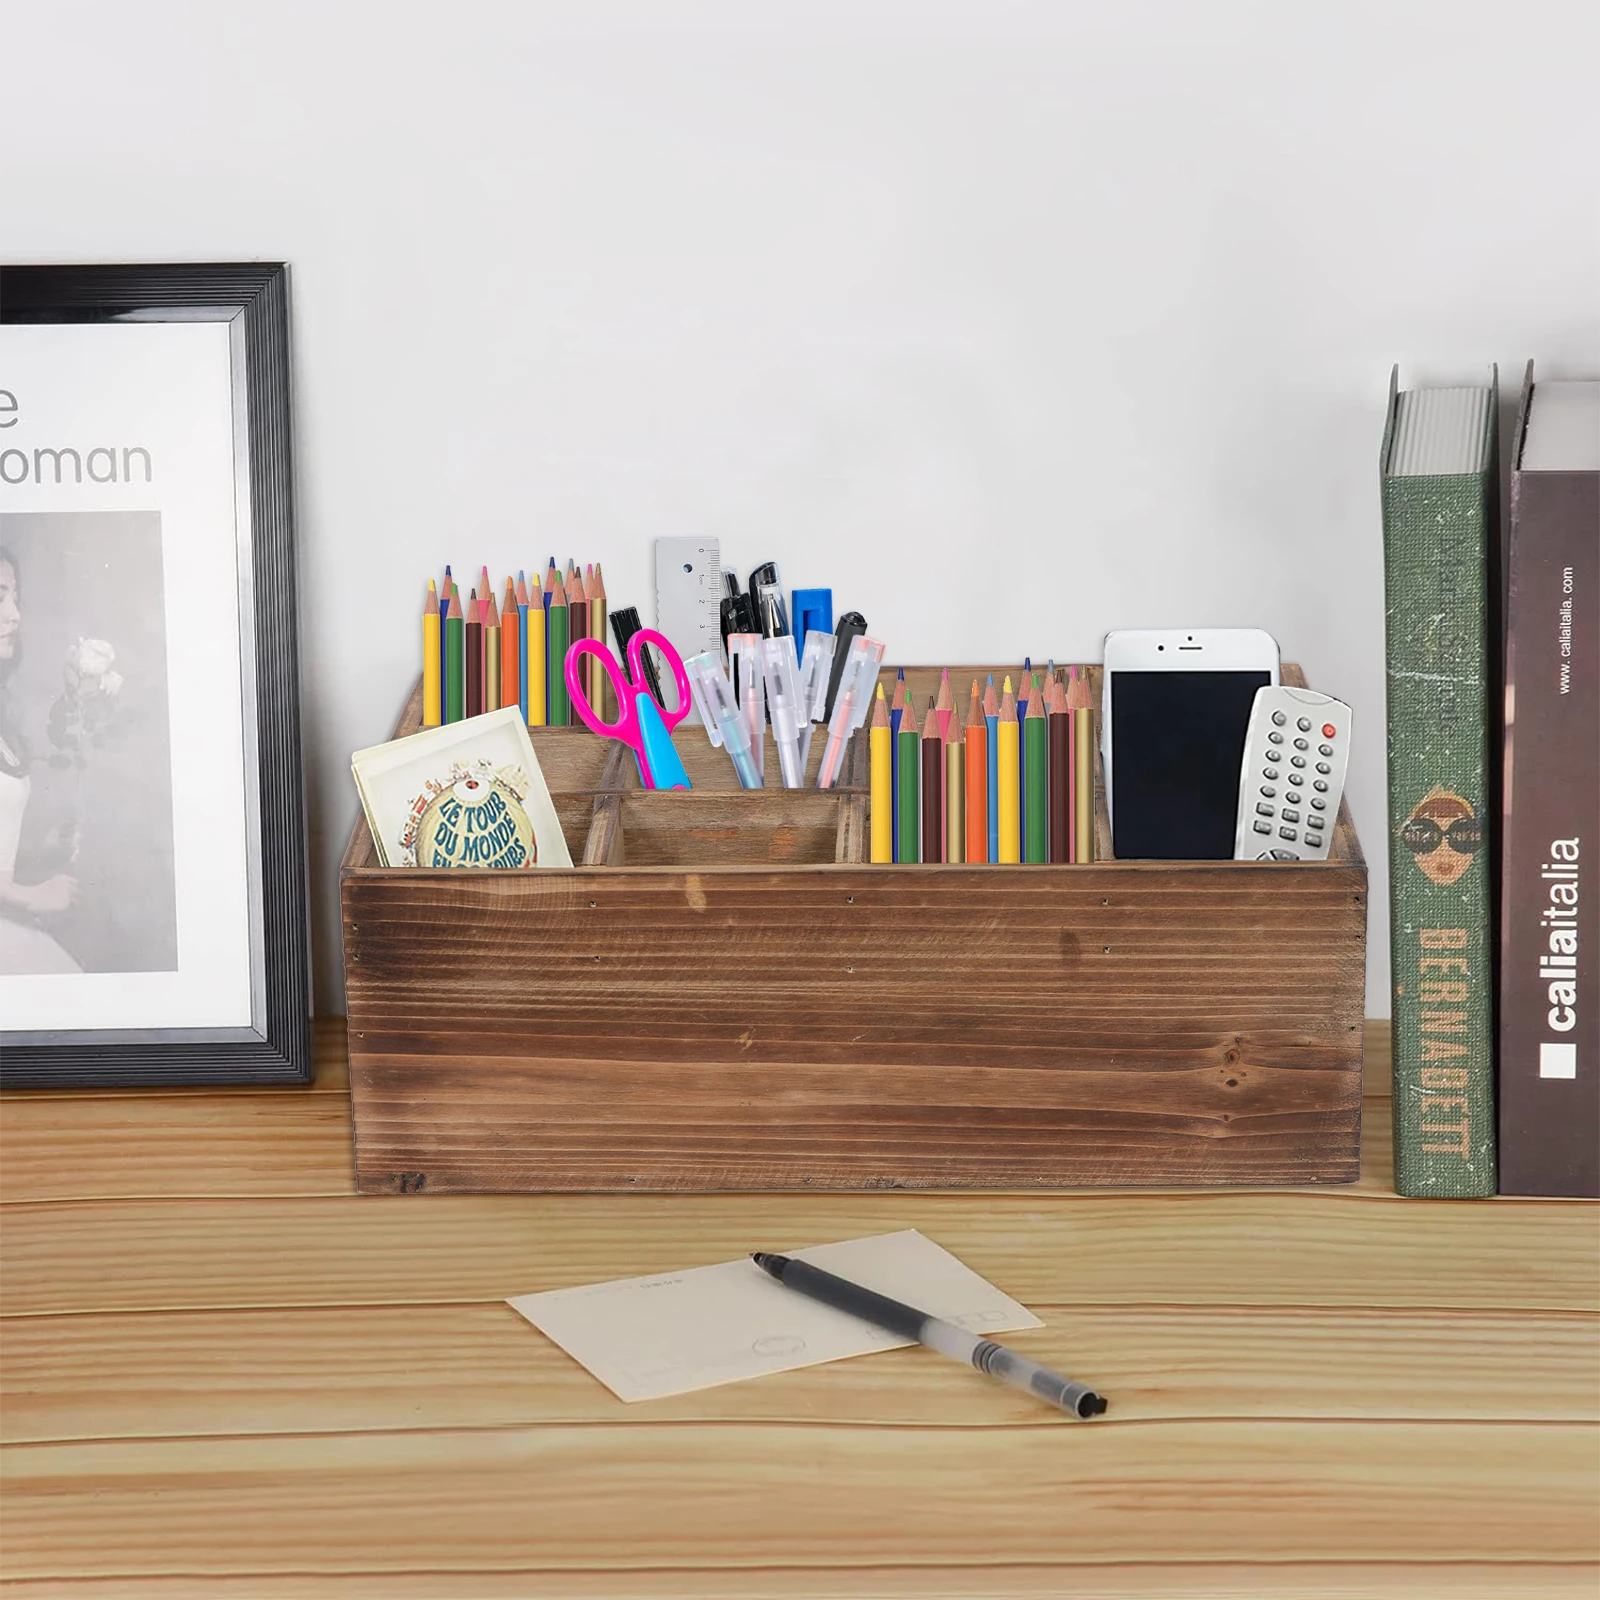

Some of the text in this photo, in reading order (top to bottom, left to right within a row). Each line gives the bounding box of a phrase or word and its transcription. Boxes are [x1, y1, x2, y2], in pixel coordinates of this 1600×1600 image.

[439, 791, 506, 833] LE TOUR
[434, 811, 517, 862] DU MONDE
[487, 837, 526, 868] URS
[1540, 838, 1579, 1032] caliaitalia
